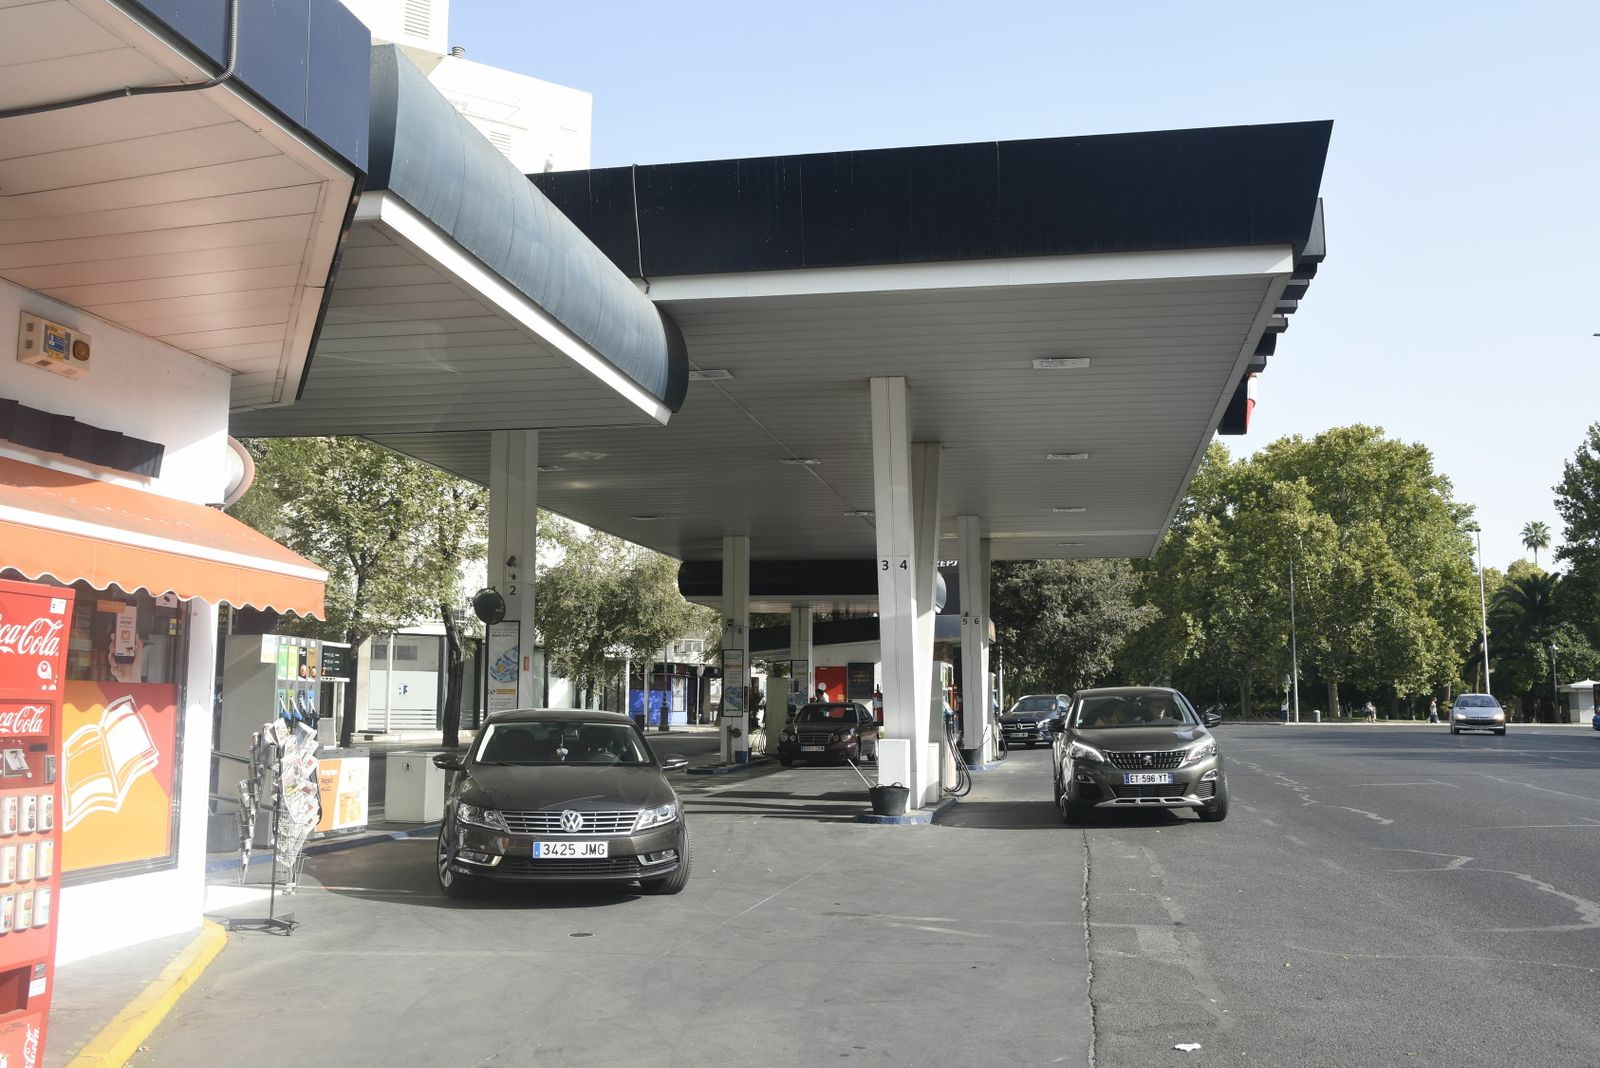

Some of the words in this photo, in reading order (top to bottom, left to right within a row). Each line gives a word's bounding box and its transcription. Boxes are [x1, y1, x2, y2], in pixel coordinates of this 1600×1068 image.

[881, 559, 889, 571] 3
[900, 559, 908, 571] 4
[509, 585, 517, 596] 2
[0, 613, 64, 656] ca-Cola
[543, 843, 576, 856] 3425
[580, 843, 605, 856] JMG
